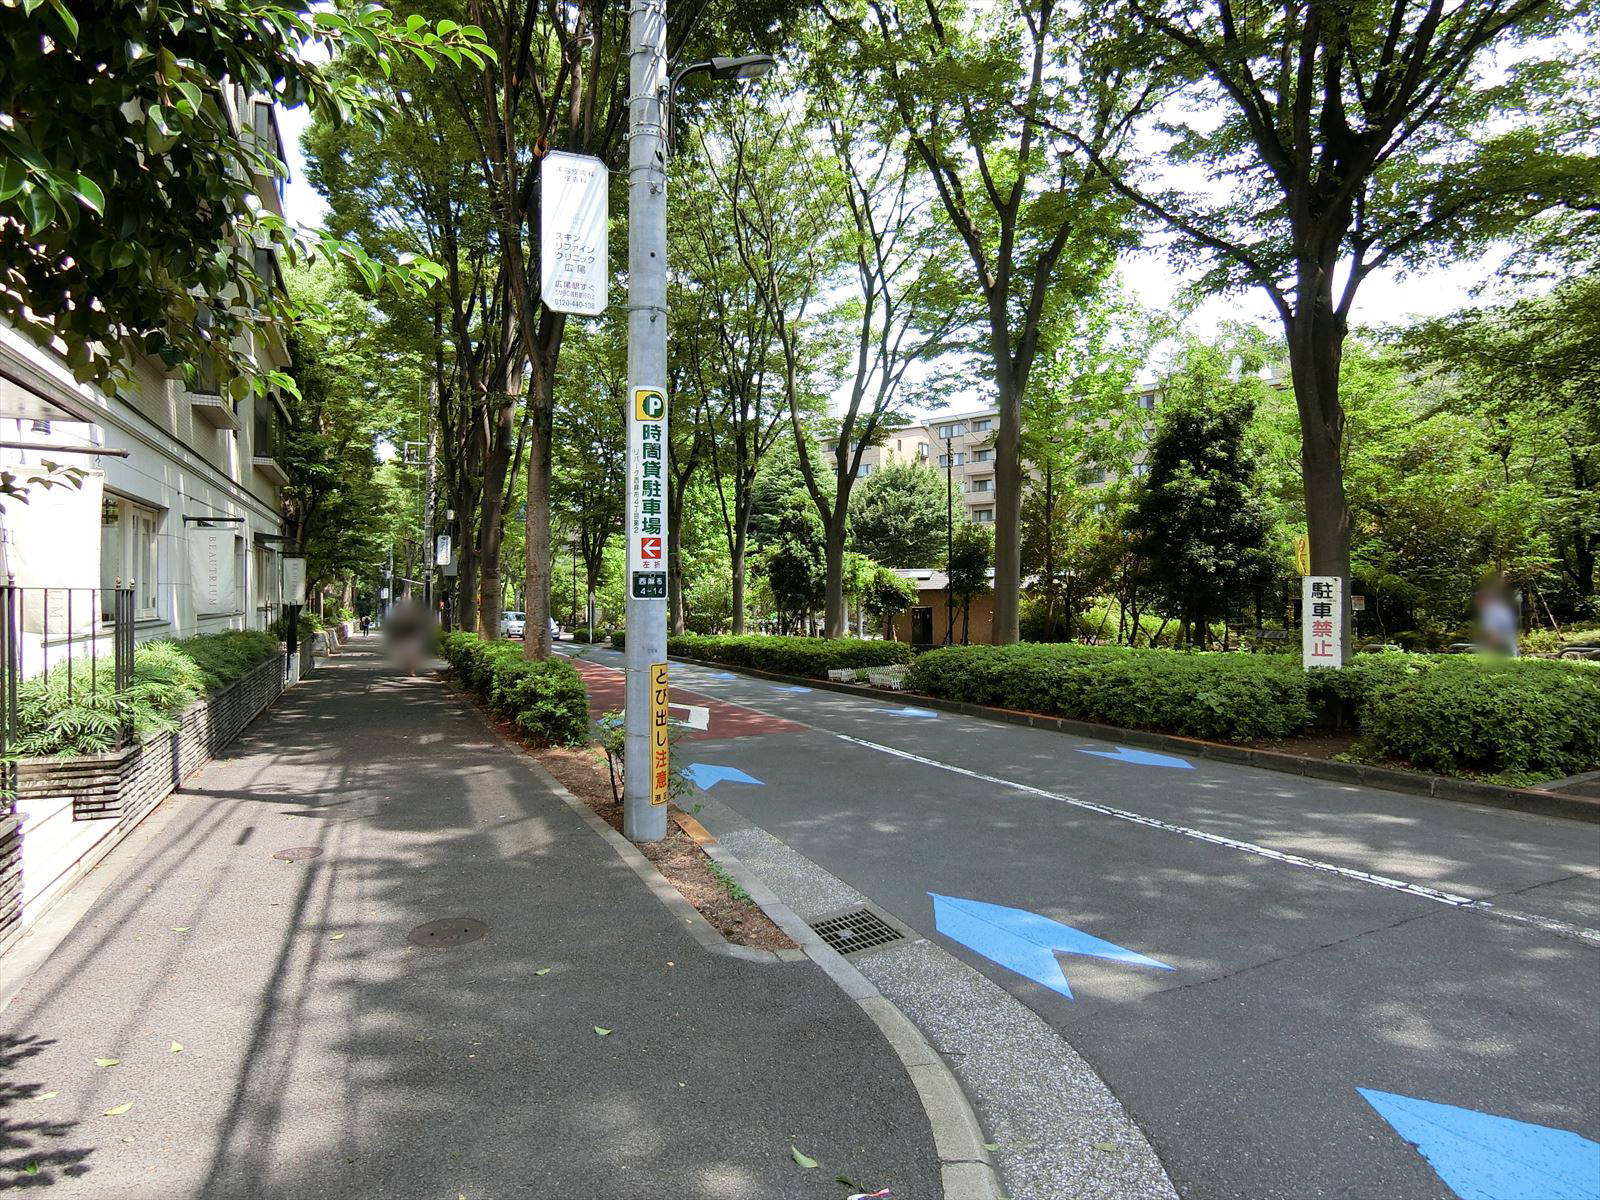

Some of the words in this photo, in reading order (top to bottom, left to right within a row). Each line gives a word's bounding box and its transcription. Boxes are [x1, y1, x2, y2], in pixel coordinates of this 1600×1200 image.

[556, 232, 581, 242] スキン
[556, 242, 595, 254] リファイン
[556, 252, 595, 264] クリニック
[565, 264, 586, 274] 広尾
[642, 424, 661, 535] 時間貸駐車場
[209, 536, 217, 606] BEAUTRIUM
[640, 587, 663, 595] 4-14
[1312, 582, 1333, 656] 駐車禁止
[655, 668, 667, 790] とび出し注意
